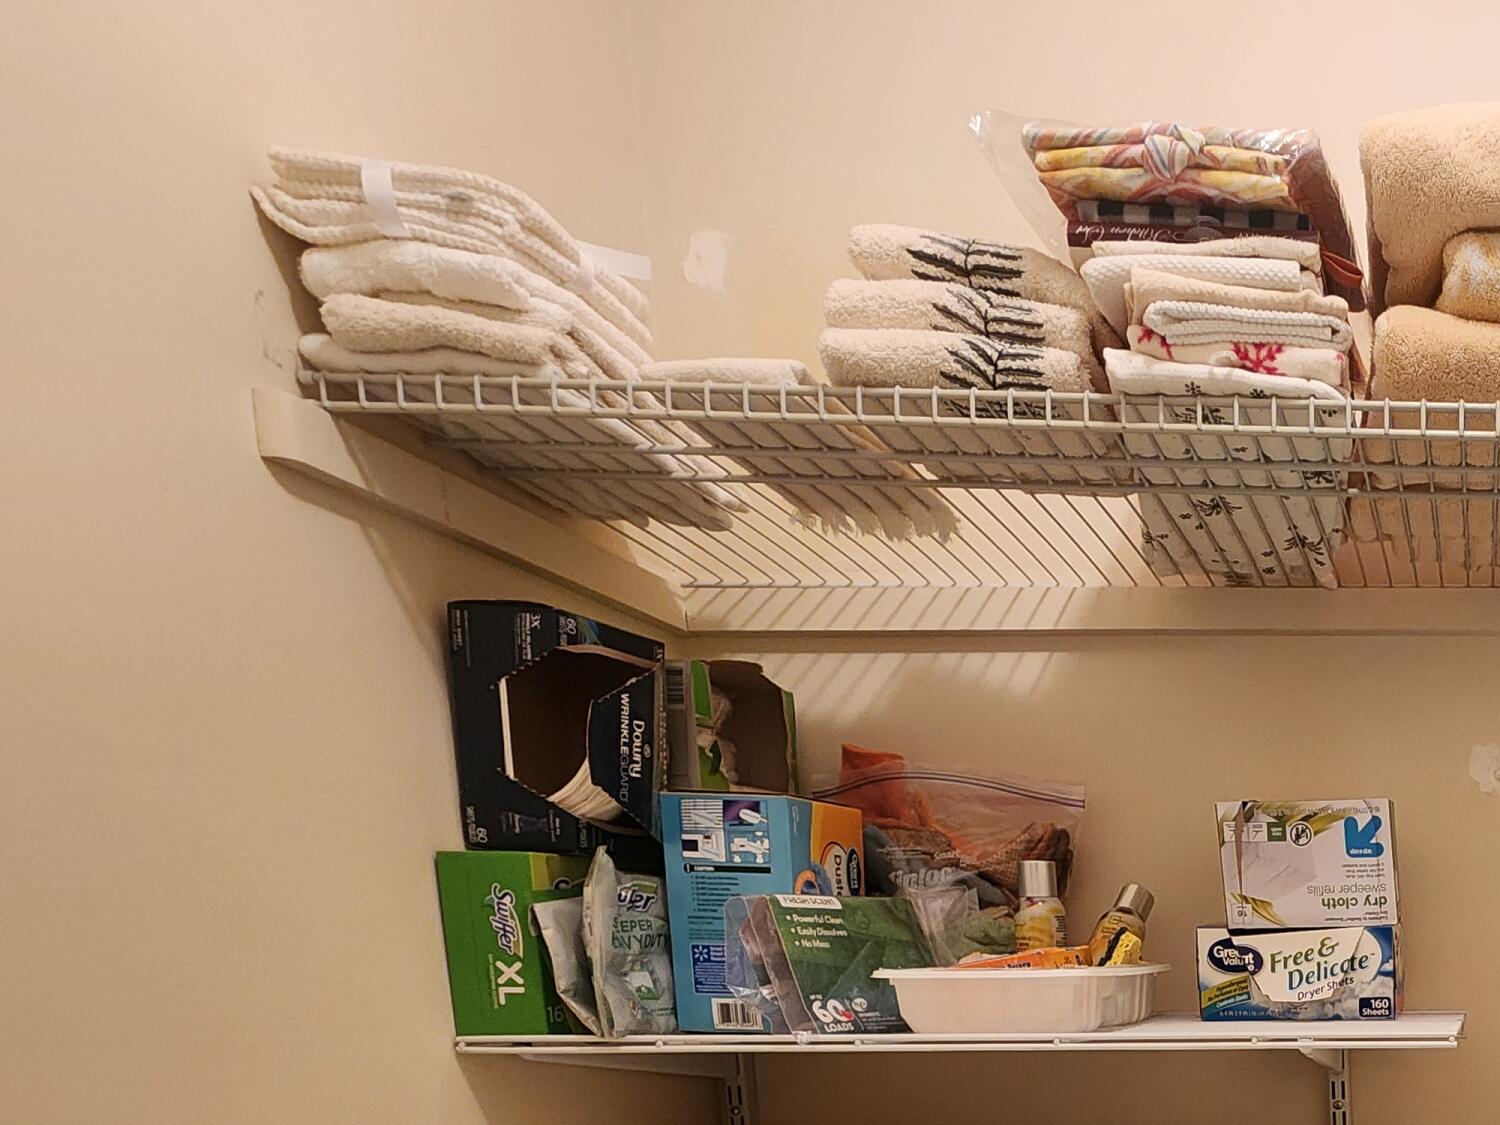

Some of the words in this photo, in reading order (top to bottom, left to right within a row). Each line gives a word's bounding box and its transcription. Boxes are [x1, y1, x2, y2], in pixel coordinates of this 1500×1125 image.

[567, 618, 577, 635] 60
[620, 693, 630, 802] WRINKLEGUARD
[628, 720, 645, 778] Downy
[476, 827, 488, 843] 60
[834, 854, 843, 896] Duste
[1307, 884, 1336, 897] refills
[1337, 882, 1387, 896] sweeper
[1321, 897, 1359, 910] cloth
[1364, 895, 1388, 909] dry
[490, 883, 518, 956] Swiffer
[792, 914, 824, 925] Powerful
[824, 914, 845, 925] Clean
[797, 926, 817, 937] Easily
[817, 927, 848, 937] Dissolves
[1270, 947, 1315, 973] Free
[1317, 936, 1339, 958] &
[495, 961, 526, 1006] XL
[1297, 986, 1325, 1001] Dryer
[812, 998, 854, 1023] 60
[1370, 999, 1390, 1009] 160
[547, 1007, 565, 1023] 16
[1362, 1008, 1390, 1017] Sheets
[824, 1022, 855, 1034] LOADS
